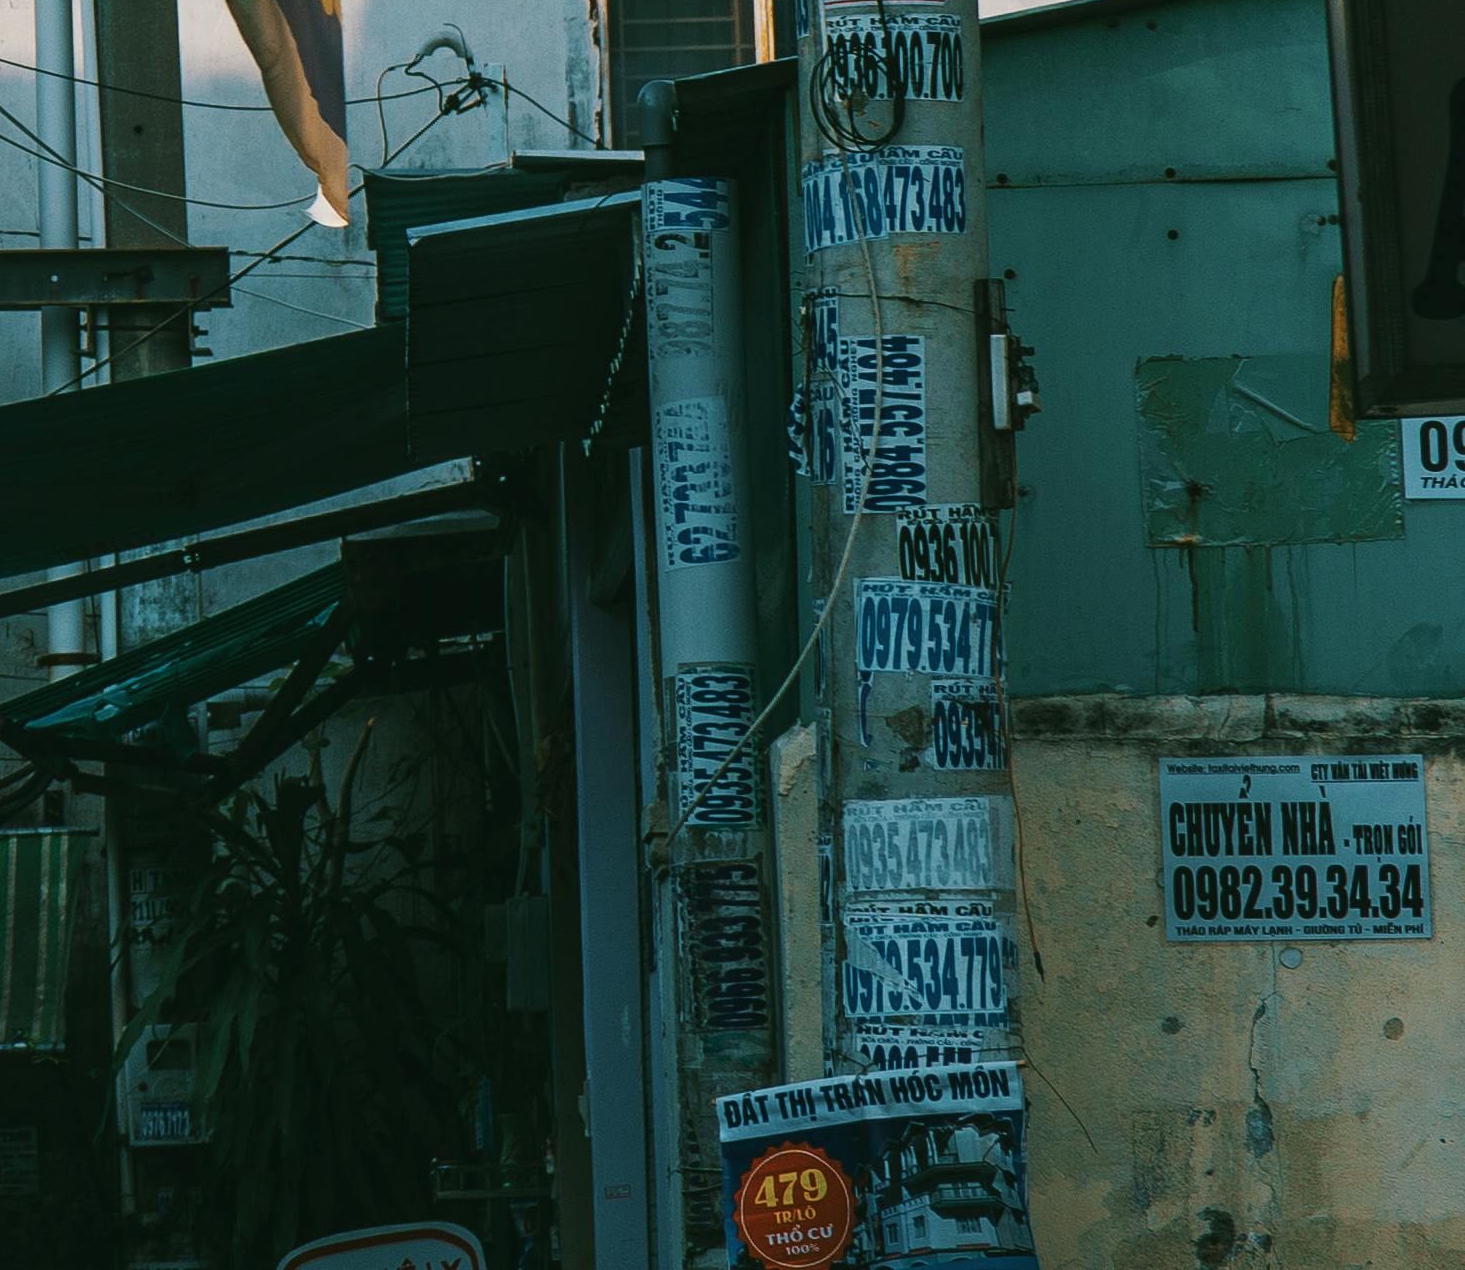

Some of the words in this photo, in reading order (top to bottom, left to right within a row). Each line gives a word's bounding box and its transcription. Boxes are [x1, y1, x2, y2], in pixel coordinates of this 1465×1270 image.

[1167, 764, 1207, 774] Website:
[1310, 763, 1329, 780] CTY
[1169, 774, 1273, 857] CHUYỂN
[1281, 784, 1336, 856] NHÀ
[1353, 823, 1394, 861] TRỌN
[1398, 815, 1423, 855] GÓI
[1172, 864, 1425, 921] 0982.39.34.34
[1234, 924, 1261, 935] MÁY
[1262, 925, 1293, 938] LẠNH
[1405, 923, 1425, 934] PHÍ
[724, 1093, 770, 1129] ĐẤT
[775, 1090, 817, 1122] THỊ
[820, 1075, 887, 1112] TRẤN
[890, 1070, 943, 1103] HÓC
[947, 1065, 1011, 1101] MÔN
[753, 1167, 829, 1209] 479
[773, 1207, 817, 1225] TR/LÔ
[765, 1218, 805, 1246] THỔ
[785, 1243, 821, 1257] 100%
